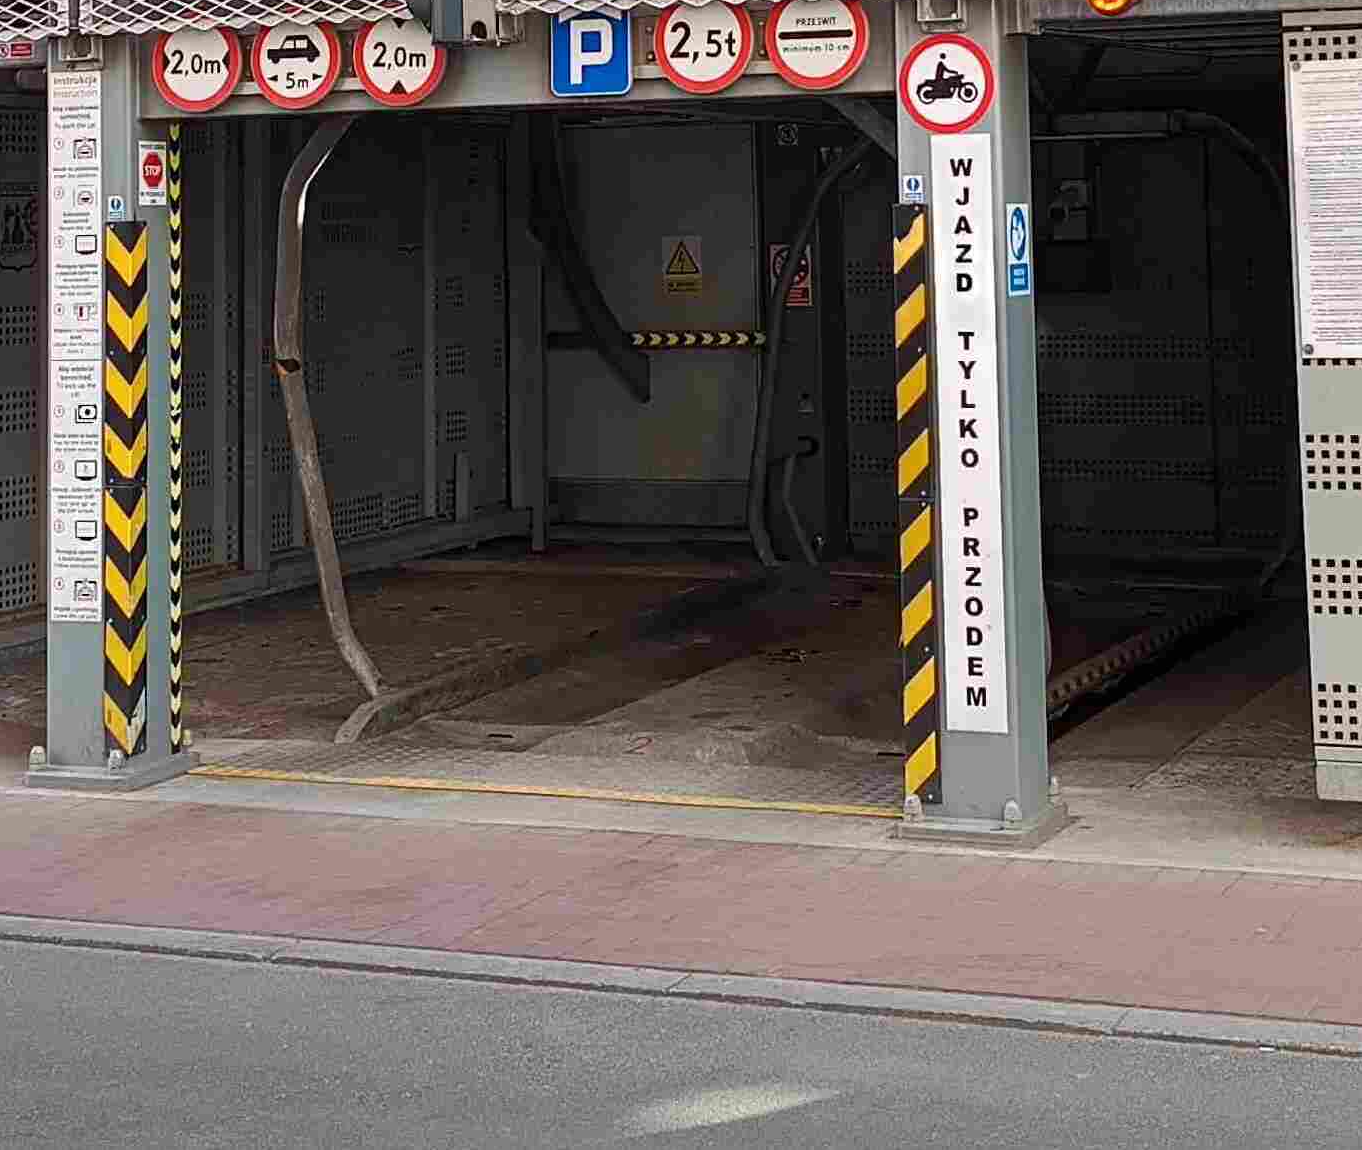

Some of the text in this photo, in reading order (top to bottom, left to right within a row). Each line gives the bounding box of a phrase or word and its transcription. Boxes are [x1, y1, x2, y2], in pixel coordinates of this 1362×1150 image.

[170, 49, 222, 77] 2,0m
[373, 41, 427, 69] 2,0m
[570, 18, 614, 86] P
[669, 21, 737, 64] 2,5t
[144, 165, 160, 176] STOP
[950, 157, 973, 292] WJAZD
[958, 331, 979, 468] TYLKO
[962, 507, 988, 707] PRZODEM
